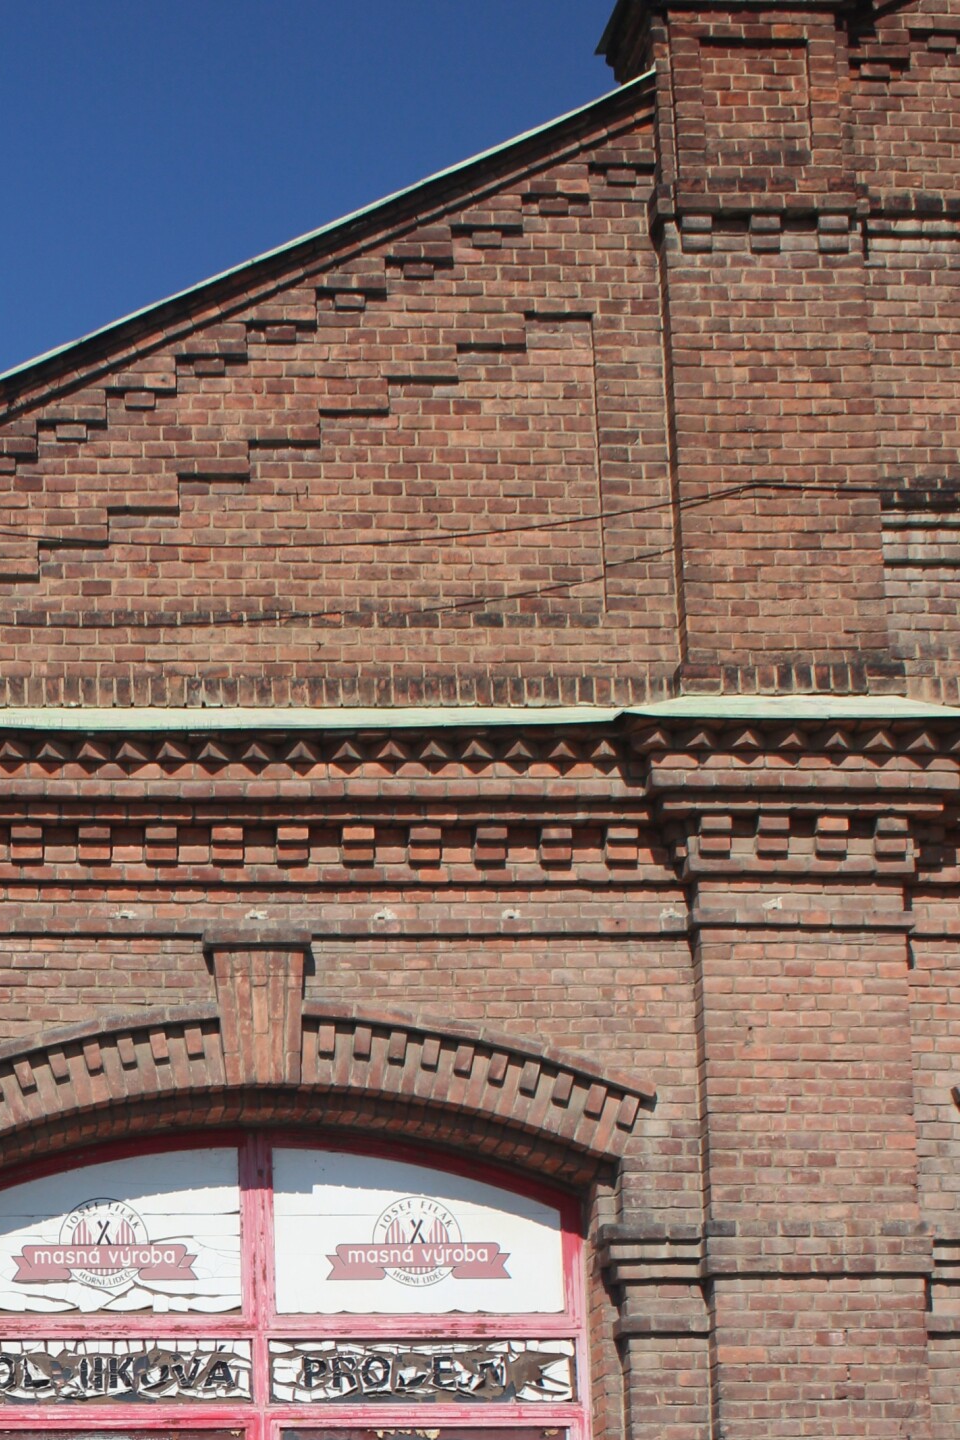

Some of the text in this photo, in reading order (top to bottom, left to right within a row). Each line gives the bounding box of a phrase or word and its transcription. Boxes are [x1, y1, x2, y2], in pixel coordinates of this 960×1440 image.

[66, 1202, 99, 1230] JOSEF
[379, 1201, 413, 1230] JOSEF
[33, 1246, 176, 1267] masná výroba
[348, 1244, 489, 1265] masná výroba
